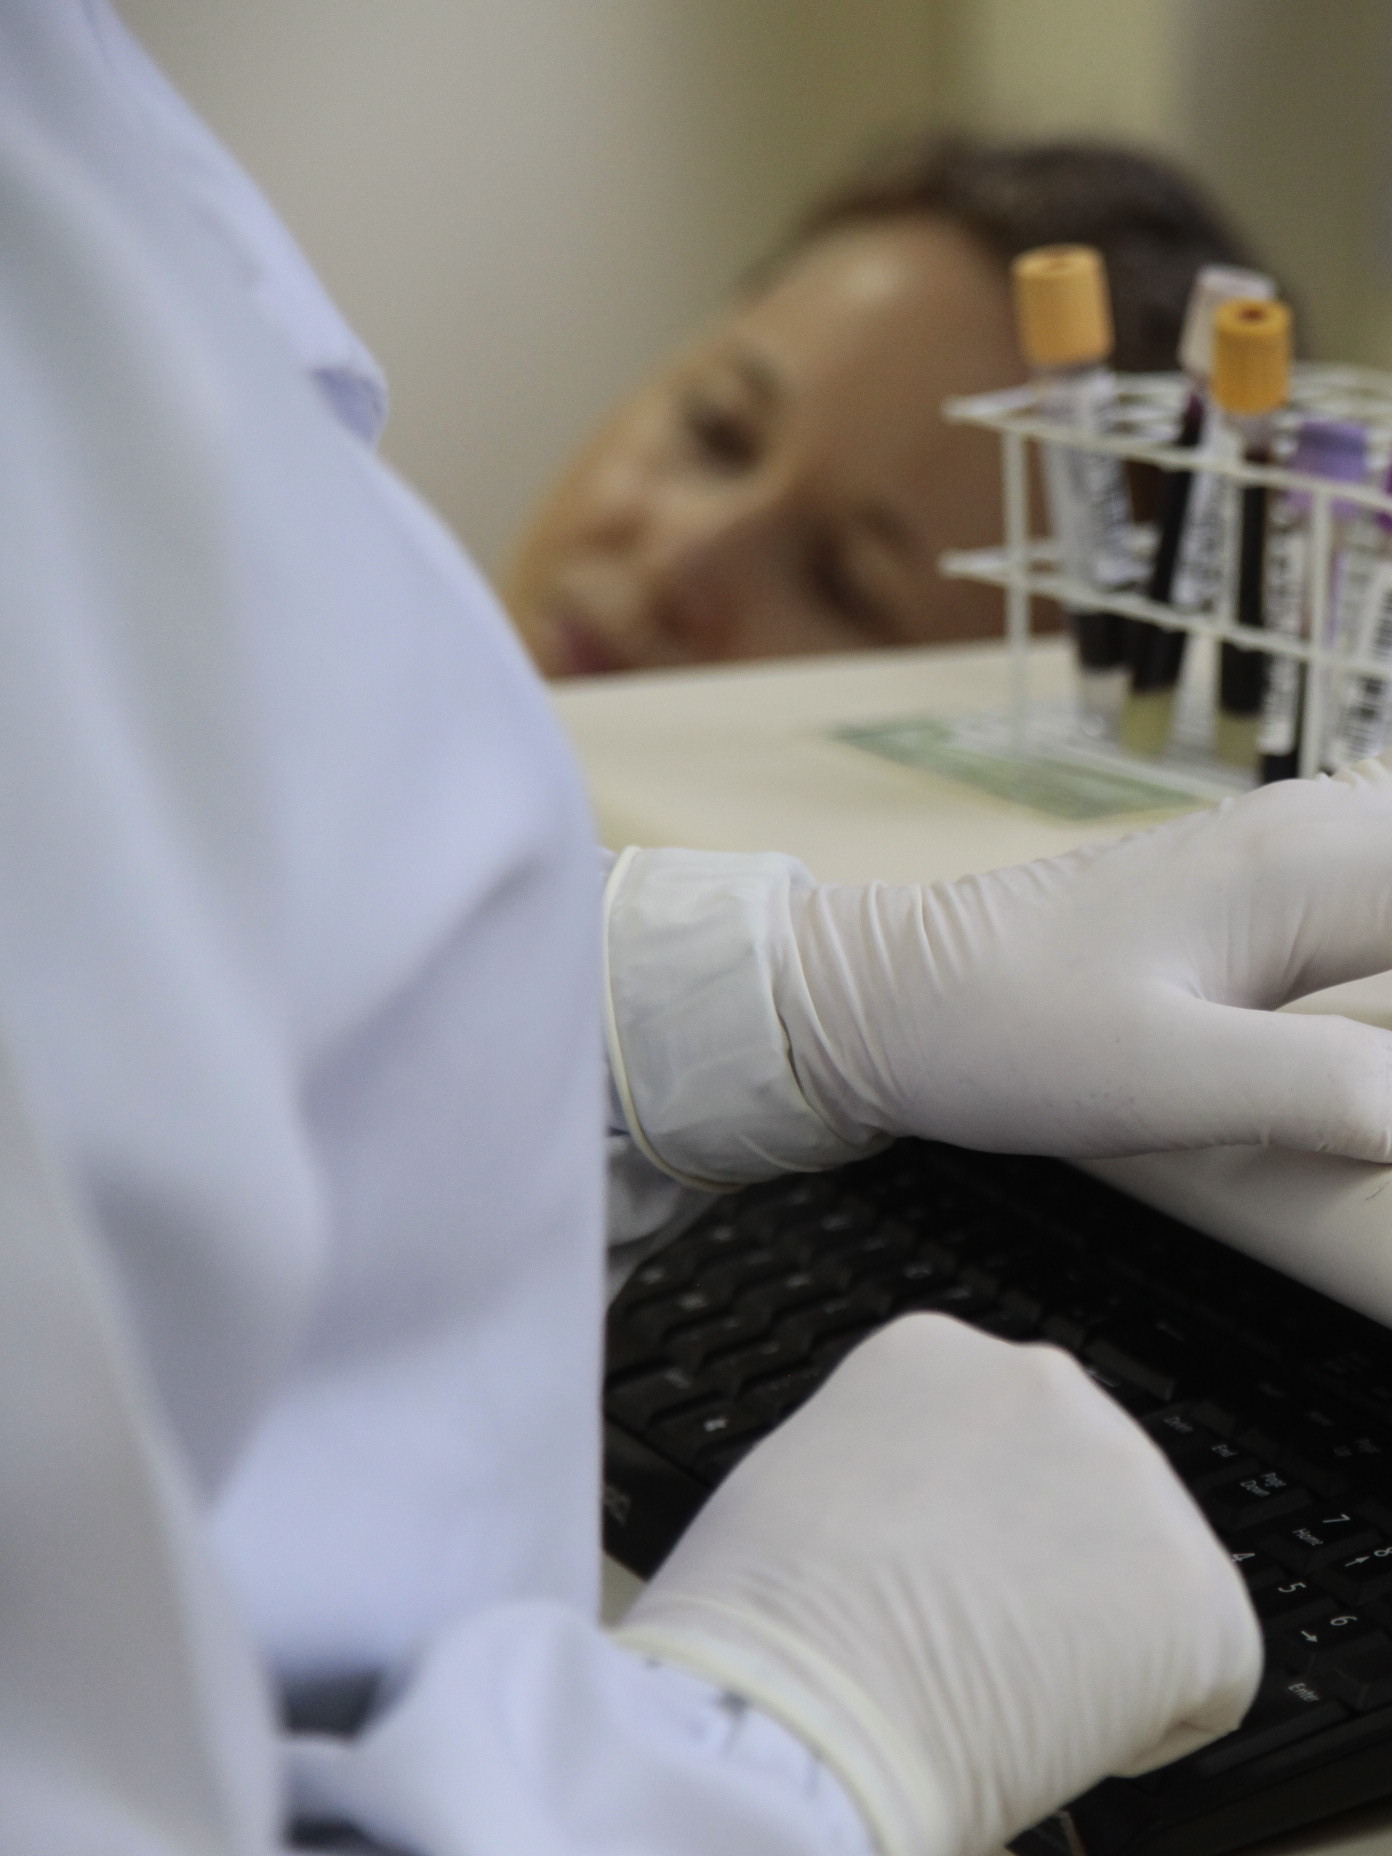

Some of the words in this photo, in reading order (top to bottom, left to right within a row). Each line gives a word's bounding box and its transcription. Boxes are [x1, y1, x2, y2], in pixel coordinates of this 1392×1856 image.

[1322, 1513, 1352, 1524] 7
[1292, 1527, 1324, 1547] Home
[1231, 1551, 1256, 1563] 4
[1278, 1581, 1307, 1594] 5
[1330, 1614, 1358, 1628] 6
[1288, 1682, 1321, 1703] Enter
